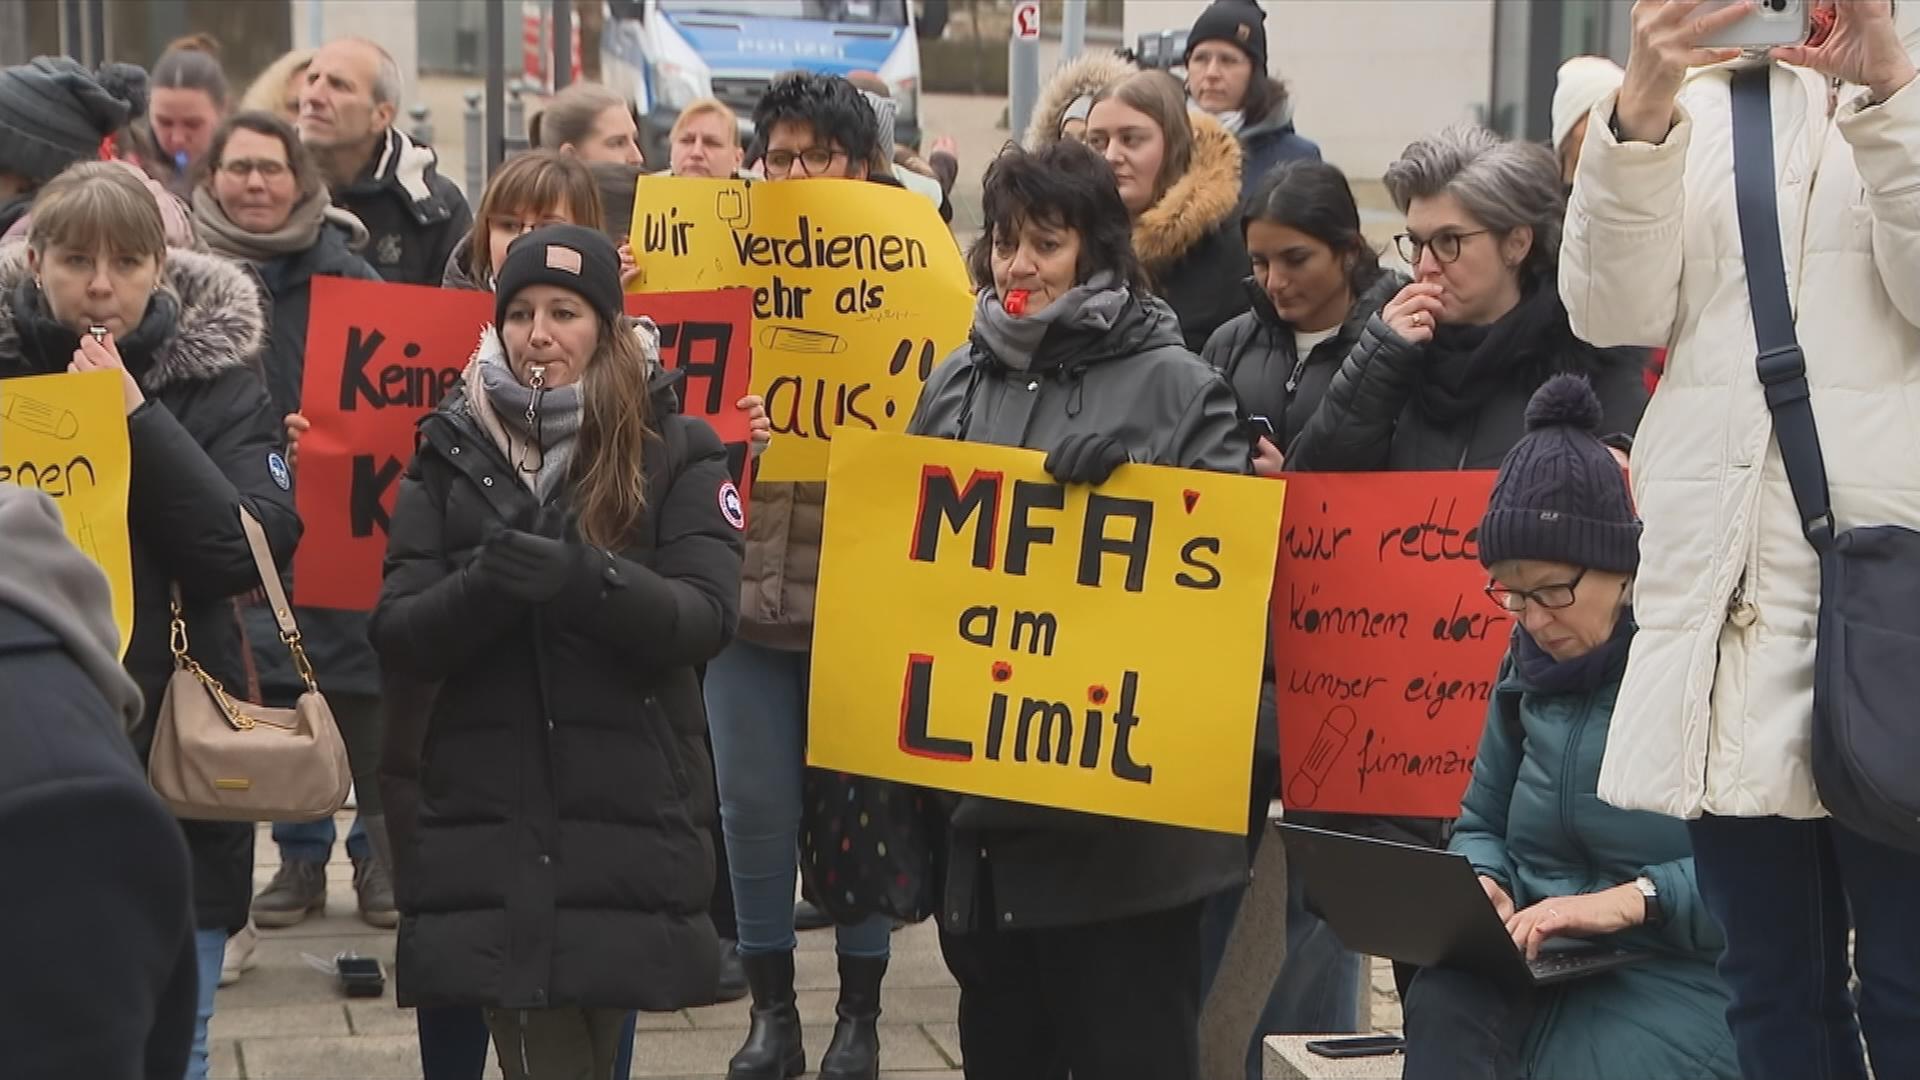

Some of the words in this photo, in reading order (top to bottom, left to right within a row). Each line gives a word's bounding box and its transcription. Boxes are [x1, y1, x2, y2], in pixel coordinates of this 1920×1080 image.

[716, 275, 812, 320] ehr
[834, 278, 885, 314] als
[909, 463, 1221, 592] MFA's
[958, 605, 1057, 656] am
[1290, 583, 1409, 640] können
[1433, 593, 1507, 642] aber
[897, 652, 1153, 784] Limit
[1288, 669, 1388, 700] unser
[1404, 671, 1494, 720] eigen
